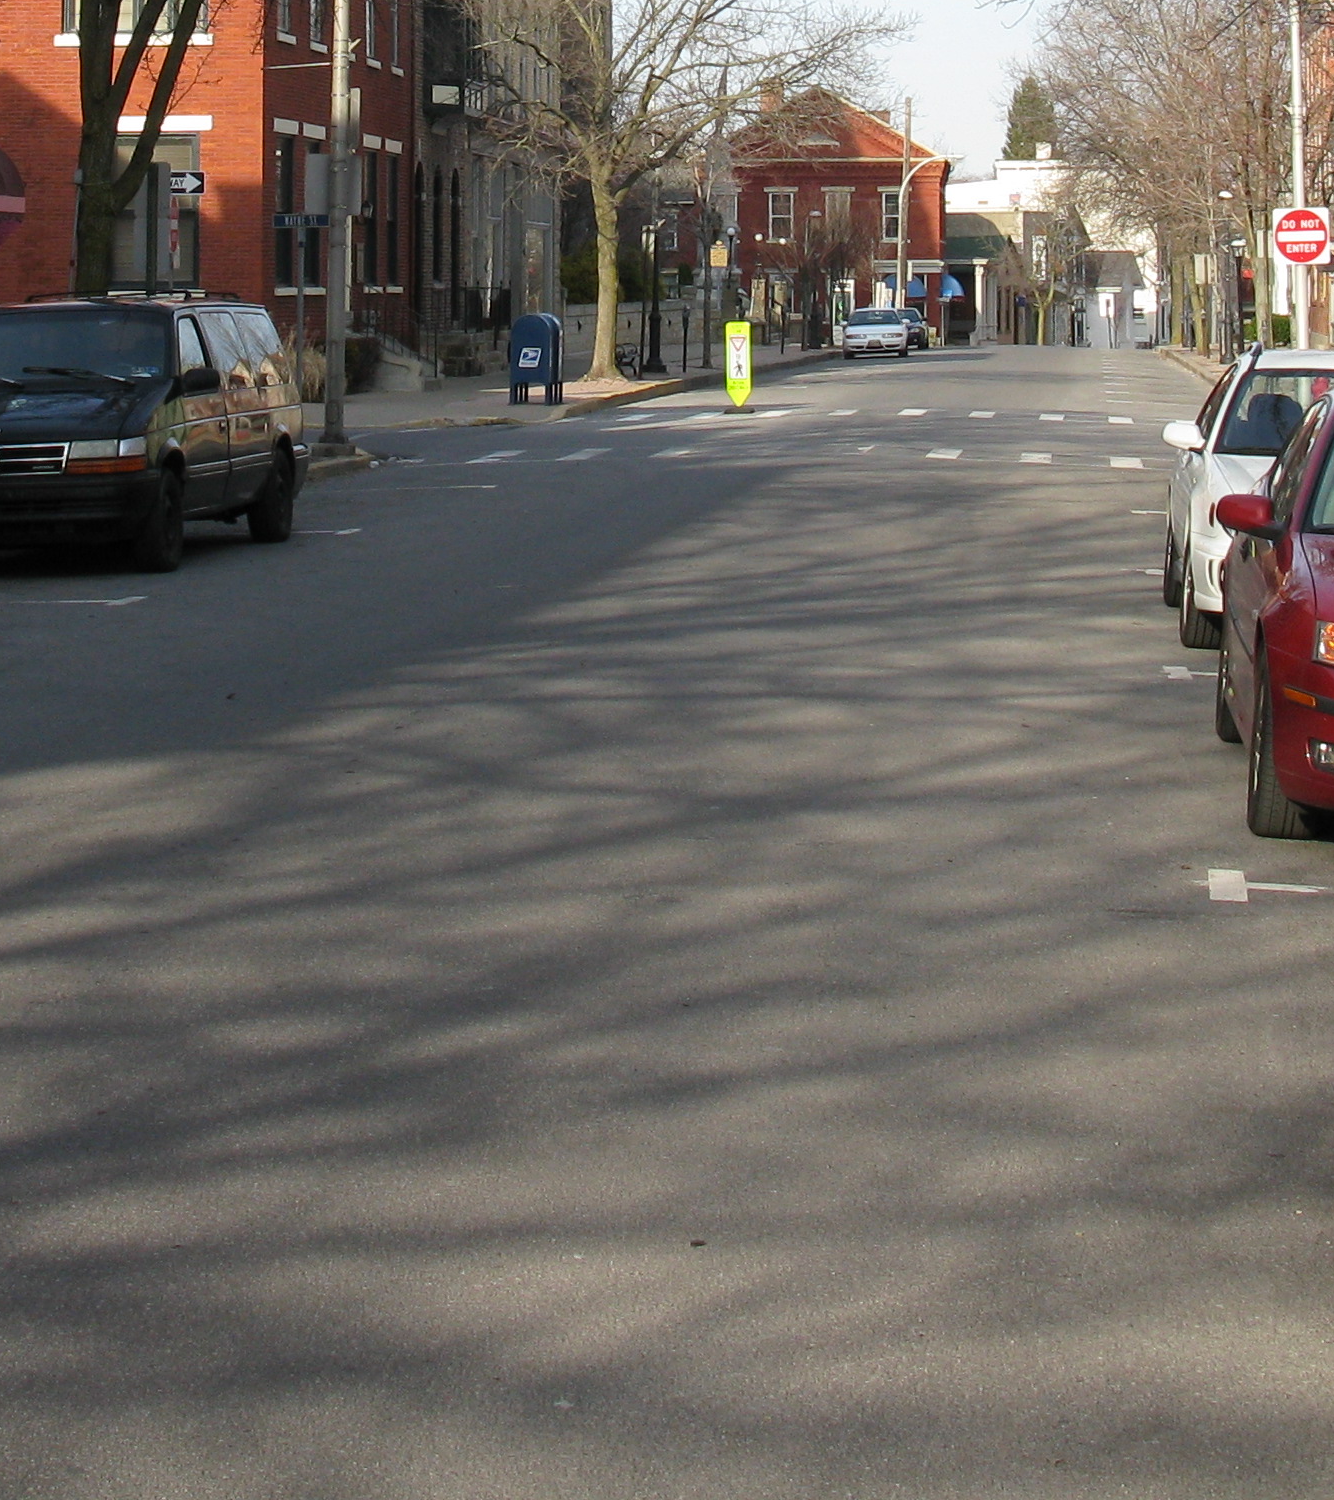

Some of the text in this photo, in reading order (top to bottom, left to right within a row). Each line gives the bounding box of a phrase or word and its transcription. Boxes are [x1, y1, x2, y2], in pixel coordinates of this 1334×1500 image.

[1282, 219, 1320, 229] DO NOT
[1285, 243, 1318, 253] ENTER
